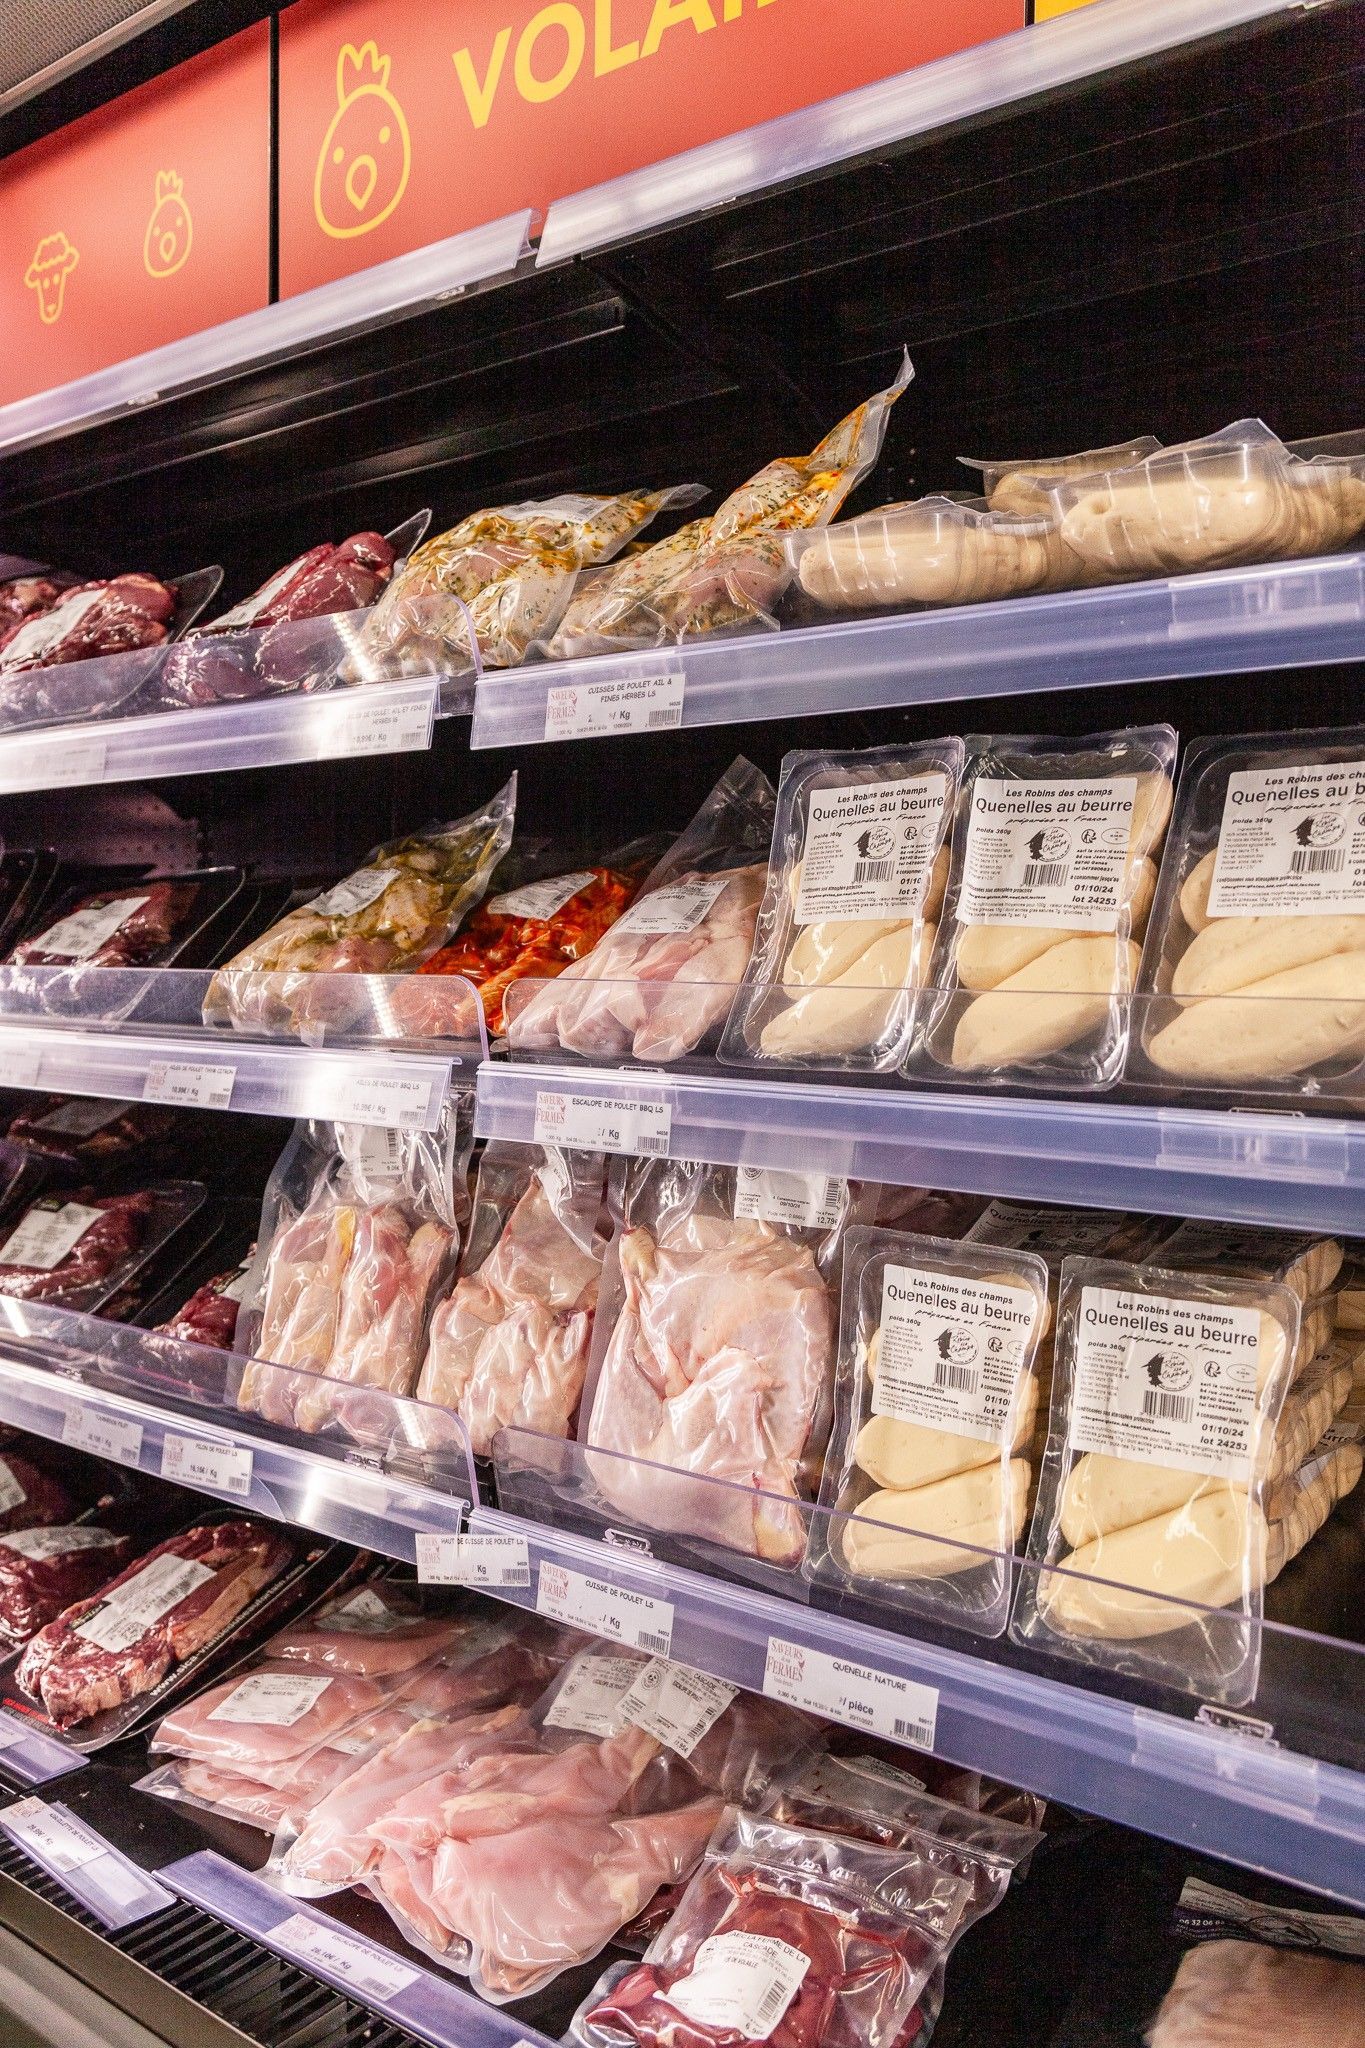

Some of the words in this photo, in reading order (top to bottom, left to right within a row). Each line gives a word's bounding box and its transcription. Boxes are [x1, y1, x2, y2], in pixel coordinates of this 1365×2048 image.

[452, 0, 779, 129] VOLA
[588, 685, 614, 694] CUISSES
[626, 680, 651, 690] POULET
[600, 694, 620, 702] FINES
[622, 691, 646, 700] HERBES
[620, 711, 630, 720] Kg
[1264, 778, 1284, 786] Les
[1286, 774, 1322, 784] Robins
[1326, 772, 1345, 781] des
[838, 796, 850, 804] Les
[852, 792, 878, 802] Robins
[880, 790, 894, 798] des
[896, 786, 928, 796] champs
[1025, 789, 1056, 798] Robins
[1058, 788, 1074, 796] des
[1077, 788, 1113, 798] champs
[1231, 786, 1320, 805] Quenelles
[1326, 786, 1348, 797] au
[812, 803, 876, 822] Quenelles
[879, 802, 896, 813] au
[900, 796, 944, 810] beurre
[976, 798, 1052, 814] Quenelles
[1056, 802, 1076, 812] au
[1080, 799, 1132, 812] beurre
[1074, 884, 1114, 893] 01/10/24
[1088, 896, 1117, 906] 24253
[378, 1104, 386, 1114] Kg
[572, 1098, 602, 1108] ESCALOPE
[604, 1100, 612, 1108] DE
[614, 1102, 638, 1111] POULET
[640, 1104, 654, 1114] BBQ
[655, 1106, 664, 1114] LS
[609, 1129, 620, 1140] Kg
[912, 1278, 928, 1288] Les
[930, 1282, 959, 1294] Robins
[961, 1288, 977, 1298] des
[979, 1291, 1014, 1305] champs
[887, 1284, 957, 1310] Quenelles
[960, 1302, 979, 1316] au
[984, 1304, 1032, 1326] beurre
[1116, 1300, 1134, 1311] Les
[1137, 1304, 1170, 1316] Robins
[1173, 1308, 1190, 1318] des
[1194, 1312, 1234, 1326] champs
[1086, 1308, 1168, 1334] Quenelles
[1174, 1323, 1194, 1338] au
[1201, 1327, 1257, 1348] beurre
[984, 1406, 995, 1415] lot
[1202, 1423, 1244, 1437] 01/10/24
[1200, 1436, 1214, 1445] lot
[1217, 1438, 1248, 1451] 24253
[494, 1538, 514, 1546] POULET
[477, 1564, 486, 1574] Kg
[586, 1580, 608, 1593] CUISSE
[610, 1588, 618, 1596] DE
[620, 1592, 643, 1605] POULET
[646, 1600, 654, 1608] LS
[610, 1616, 620, 1628] Kg
[832, 1662, 872, 1681] QUENELLE
[874, 1675, 907, 1692] NATURE
[849, 1700, 874, 1716] pièce
[743, 1941, 778, 1958] CASCADE
[783, 1946, 796, 1957] DE
[796, 1954, 806, 1964] LA
